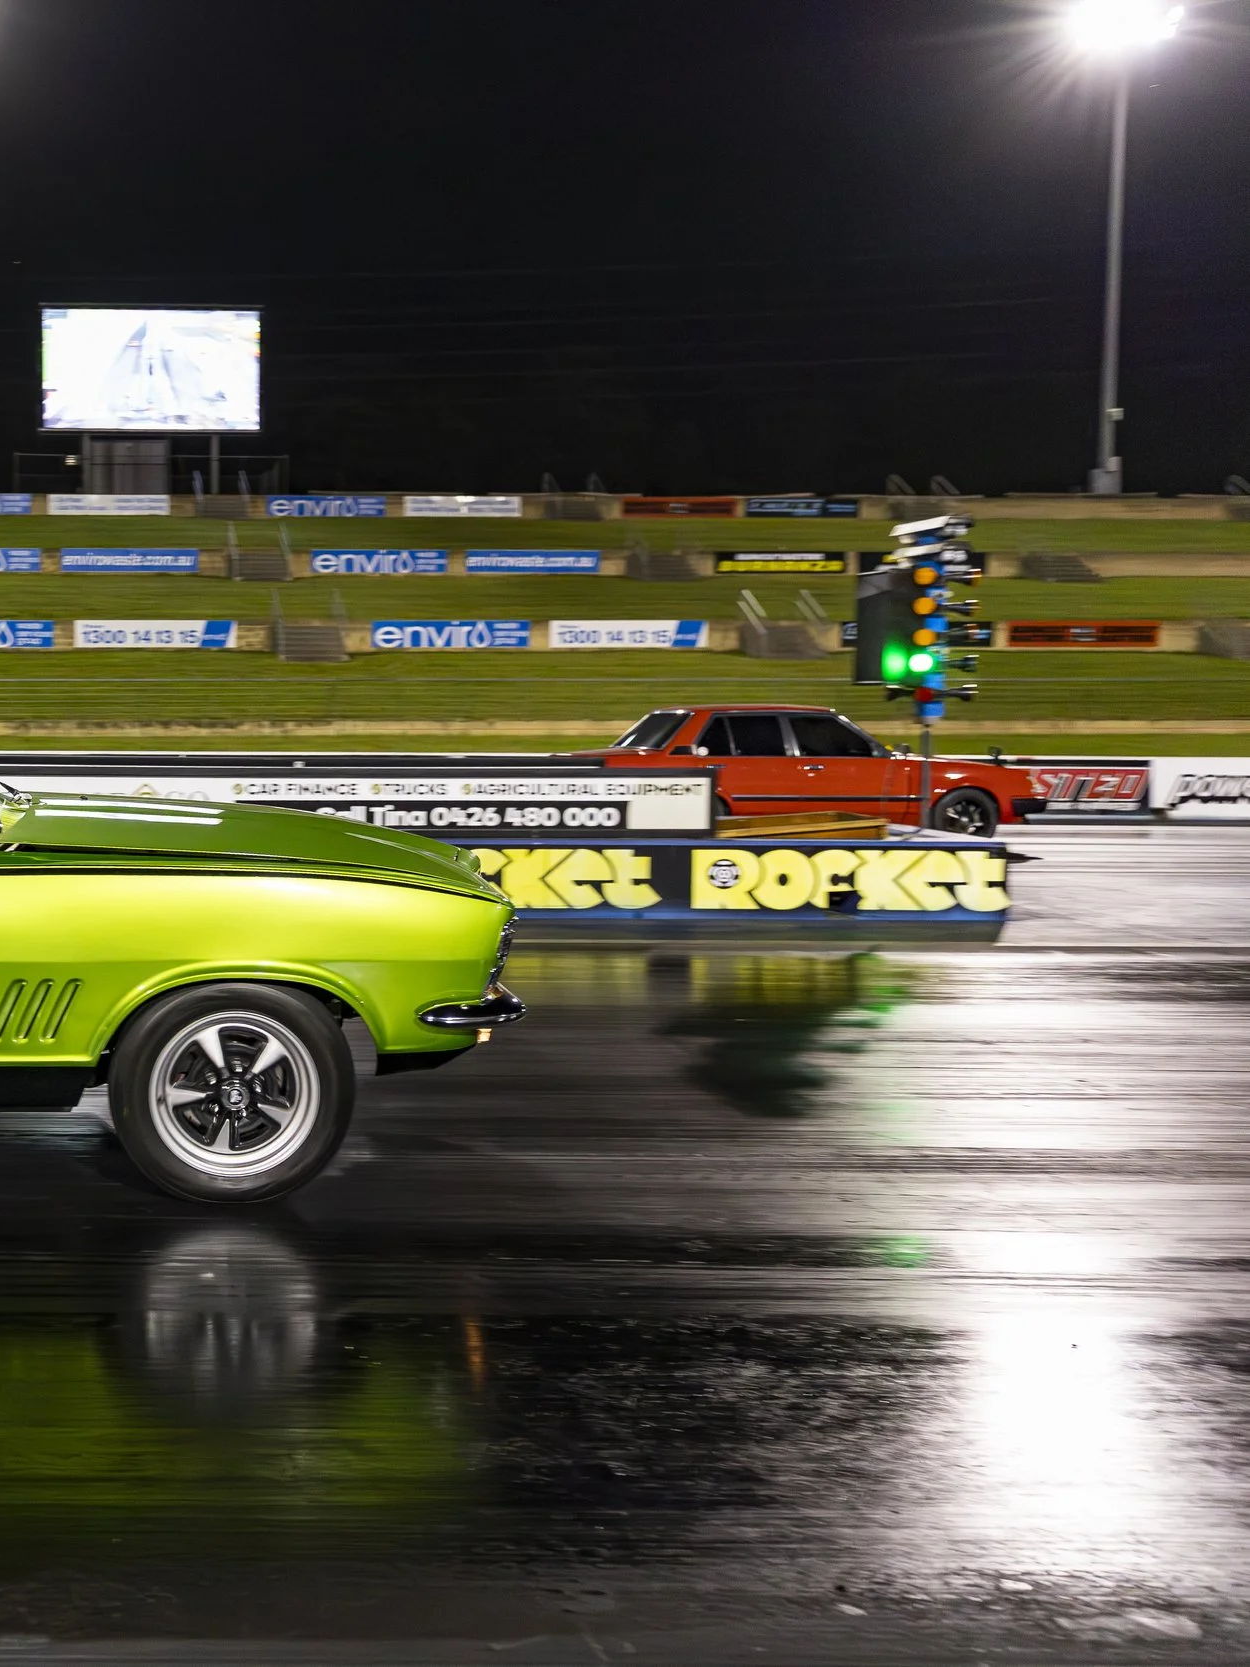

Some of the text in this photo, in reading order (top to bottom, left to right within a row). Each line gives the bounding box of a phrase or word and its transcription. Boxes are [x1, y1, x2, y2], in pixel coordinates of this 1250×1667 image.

[82, 630, 128, 643] 1300
[131, 630, 152, 643] 14
[155, 630, 175, 643] 13
[178, 630, 200, 643] 15
[557, 630, 601, 643] 1300
[605, 630, 624, 643] 14
[628, 630, 648, 643] 13
[651, 630, 672, 643] 15
[286, 783, 359, 796] FINANCE
[381, 783, 449, 796] TRUCKS
[474, 783, 600, 796] AGRICULTURAL
[605, 783, 706, 796] EQUIPMENT
[369, 804, 429, 826] Tina
[429, 807, 502, 827] 0426
[503, 807, 561, 827] 480
[562, 807, 621, 827] 000
